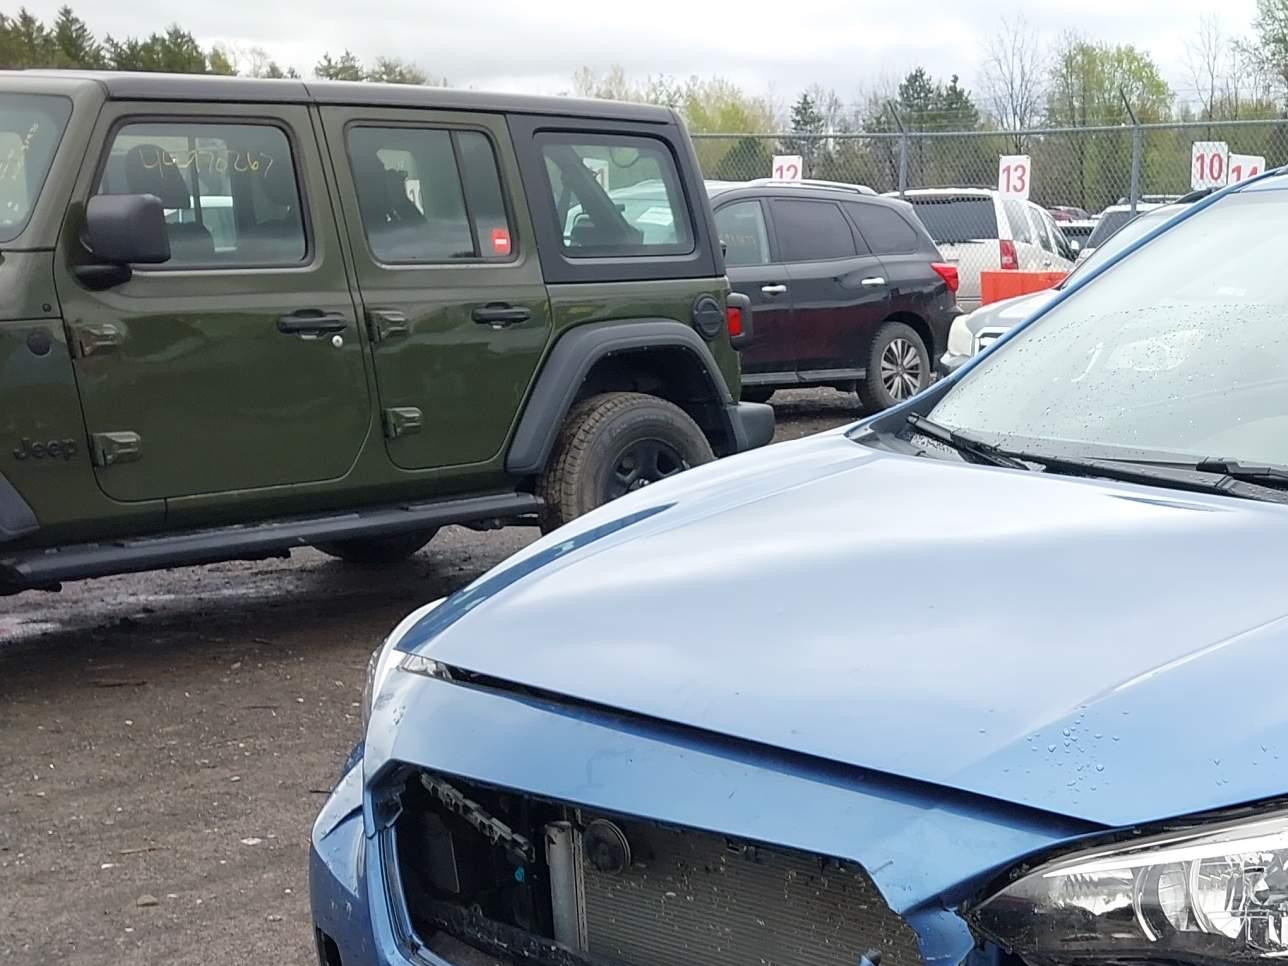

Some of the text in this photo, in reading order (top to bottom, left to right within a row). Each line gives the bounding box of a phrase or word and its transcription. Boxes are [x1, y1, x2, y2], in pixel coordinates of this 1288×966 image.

[1002, 164, 1026, 193] 13
[1196, 153, 1223, 181] 10
[13, 436, 78, 461] Jeep
